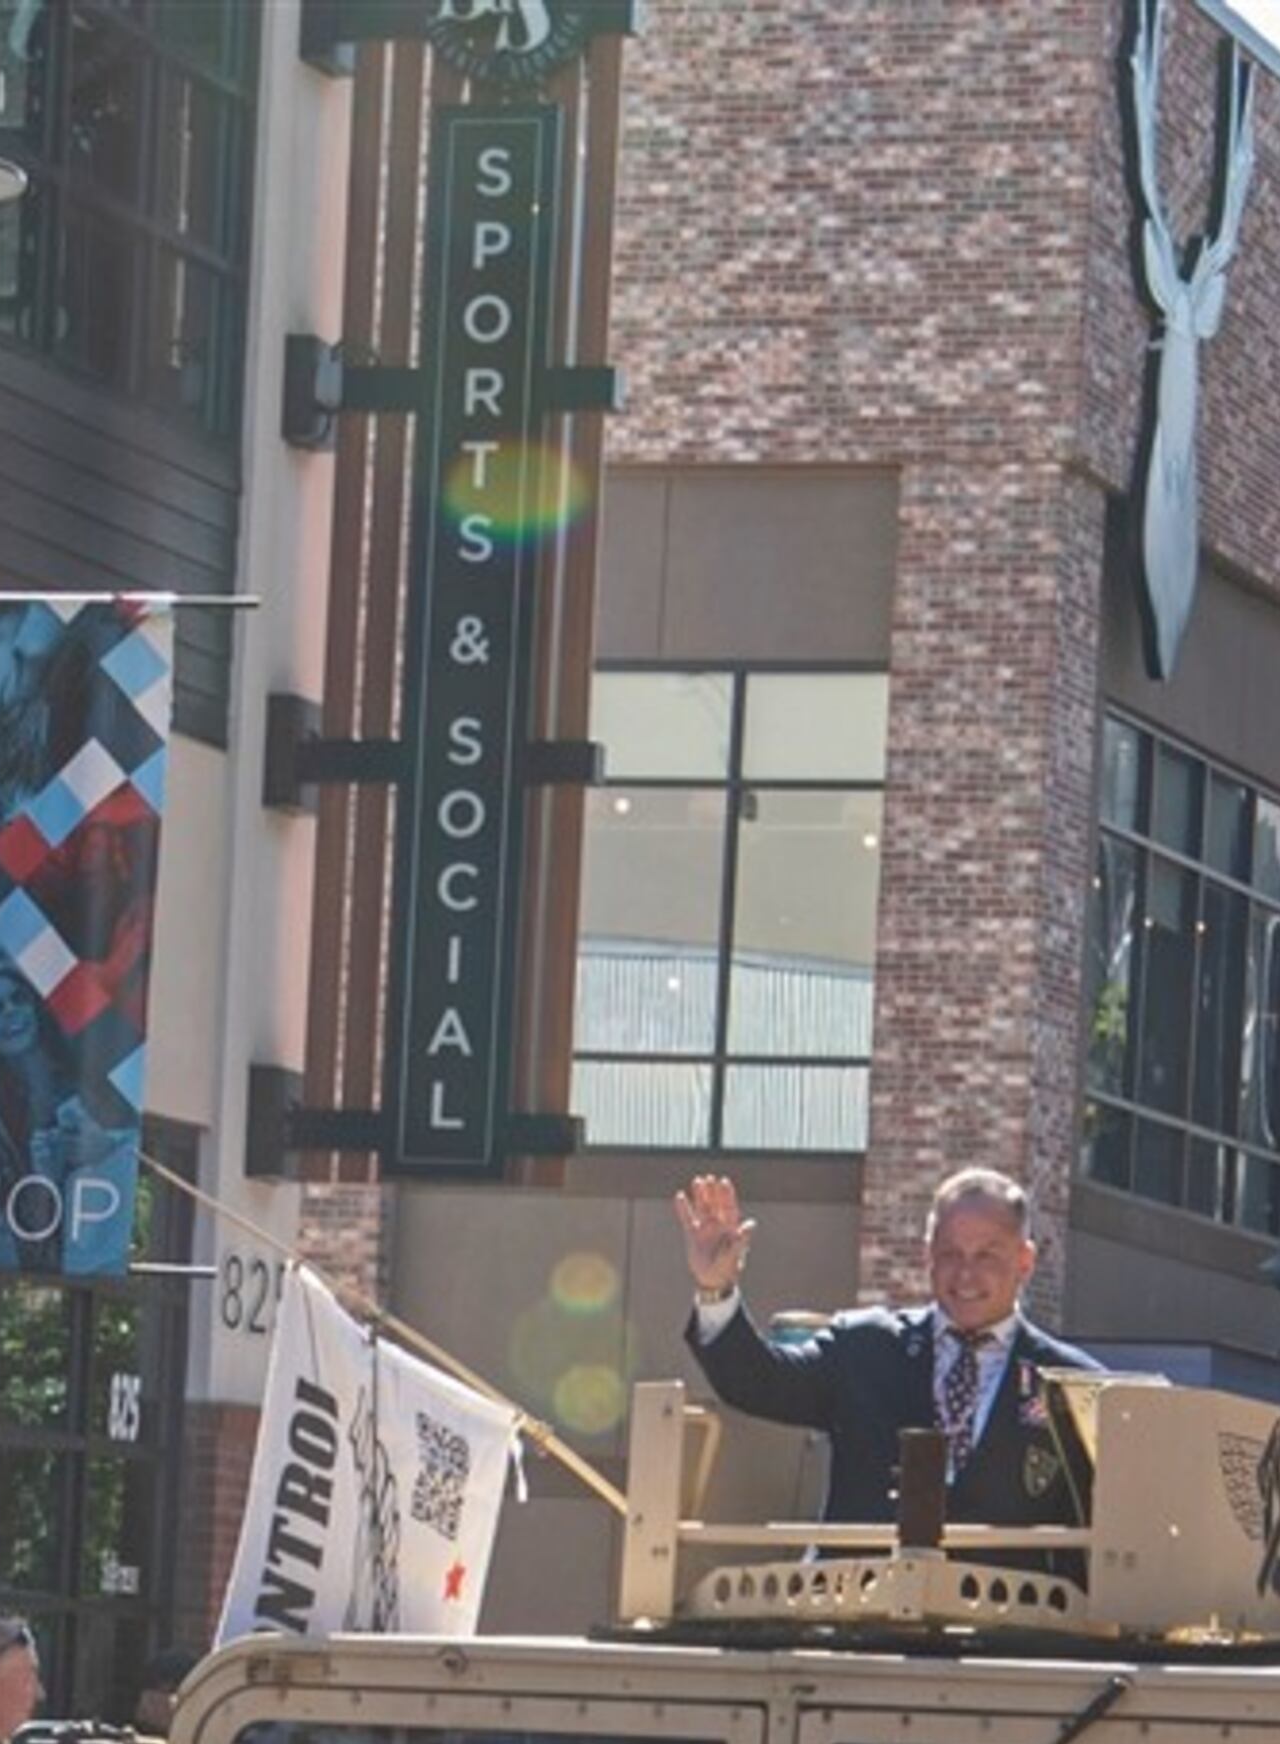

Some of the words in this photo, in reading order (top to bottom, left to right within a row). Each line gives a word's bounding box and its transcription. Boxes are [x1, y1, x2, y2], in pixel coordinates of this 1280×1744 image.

[458, 147, 512, 563] SPORTS
[449, 615, 490, 664] &
[427, 717, 486, 1129] SOCIAL
